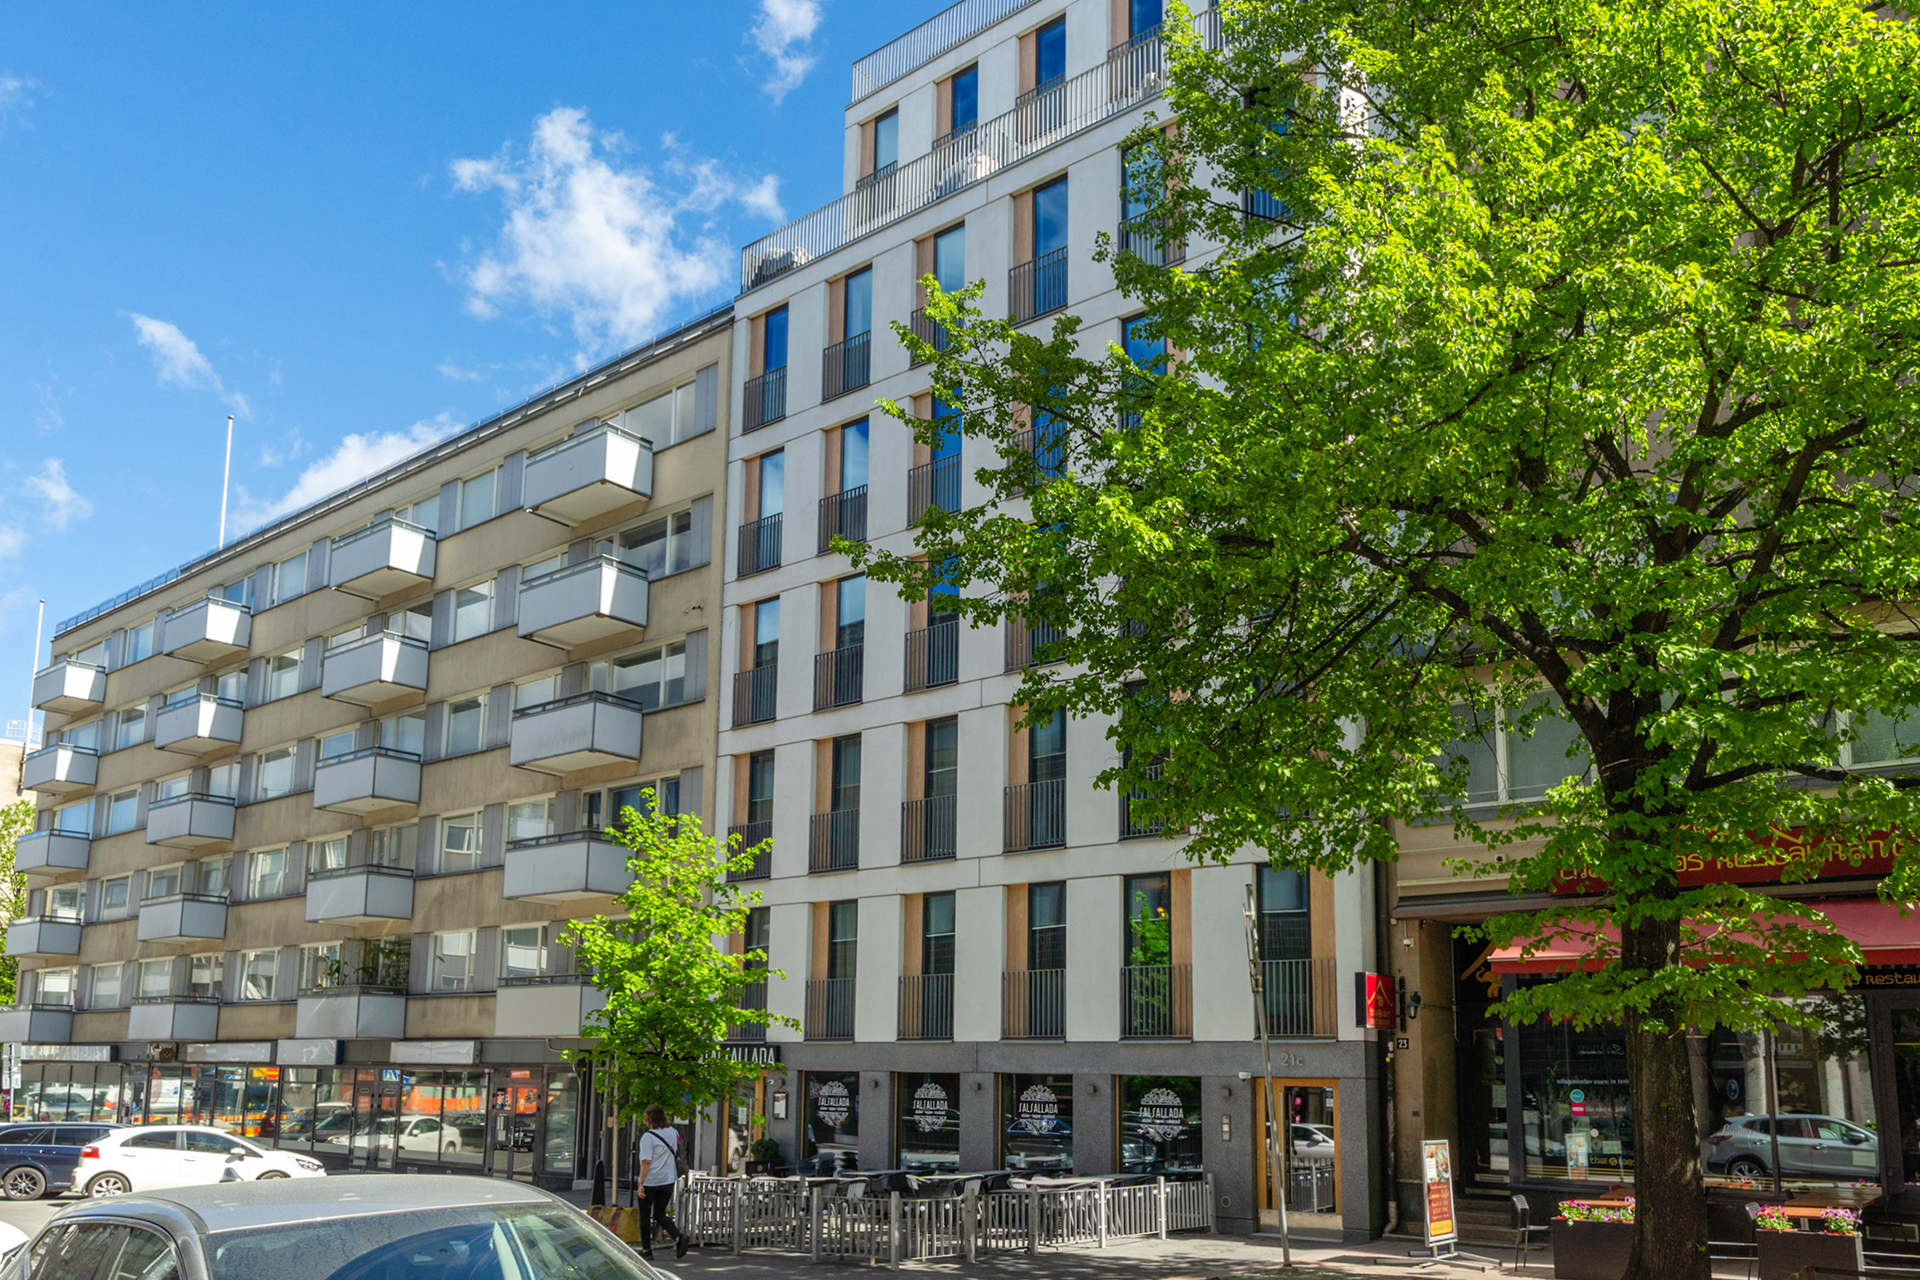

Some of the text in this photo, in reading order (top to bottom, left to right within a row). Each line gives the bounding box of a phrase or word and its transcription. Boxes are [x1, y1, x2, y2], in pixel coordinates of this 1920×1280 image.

[1398, 1040, 1407, 1048] 23
[1281, 1053, 1304, 1067] 21c
[818, 1097, 850, 1106] SALSALLADA
[912, 1100, 948, 1110] SALSALLADA
[1018, 1102, 1058, 1114] SALSALLADA
[1138, 1107, 1184, 1119] SALSALLADA
